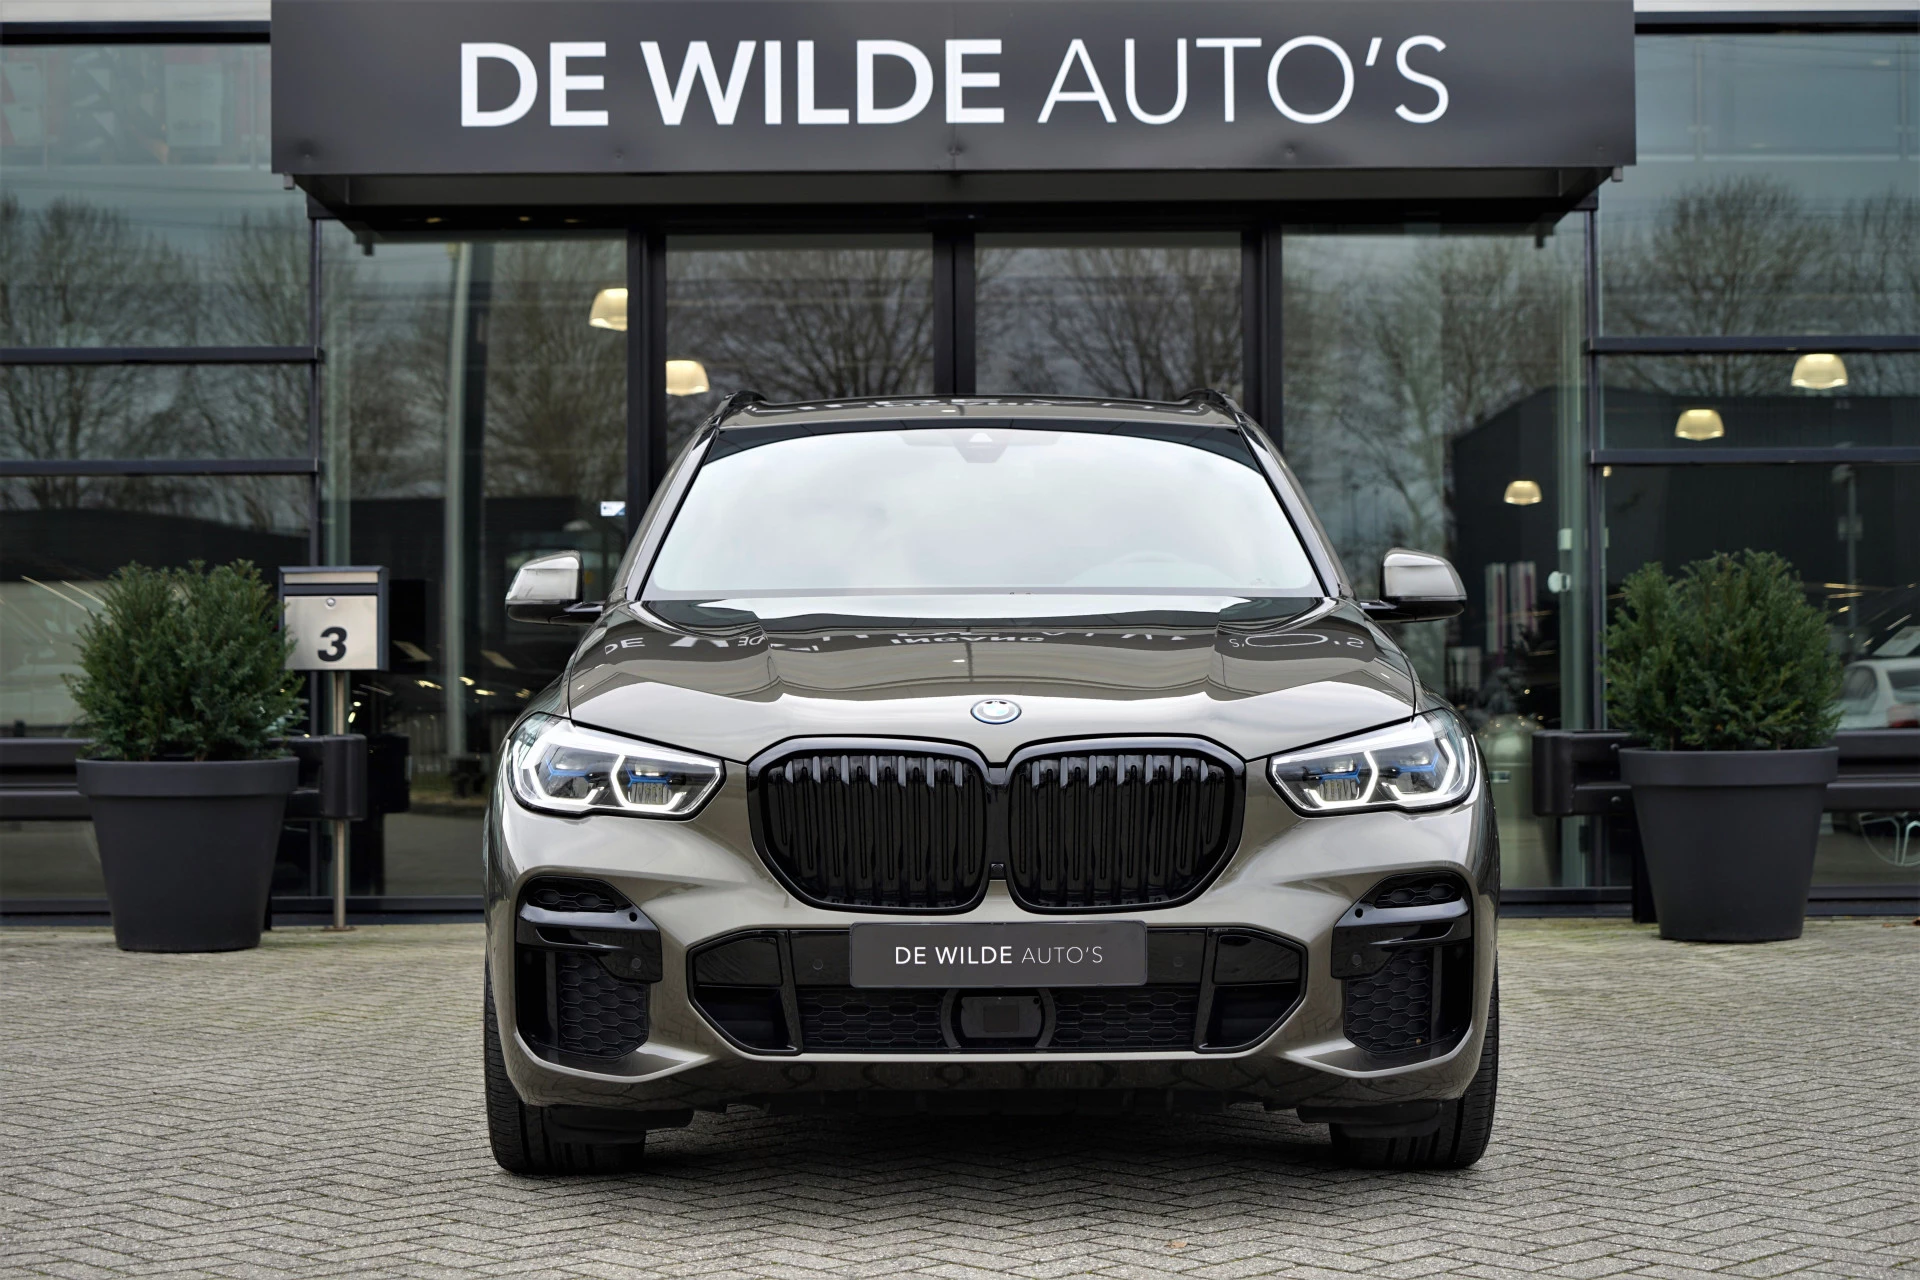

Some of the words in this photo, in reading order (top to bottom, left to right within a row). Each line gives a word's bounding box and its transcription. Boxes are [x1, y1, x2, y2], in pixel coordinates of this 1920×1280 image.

[460, 41, 609, 127] DE
[639, 38, 1005, 126] WILDE
[1037, 35, 1449, 125] AUTO'S
[317, 626, 348, 662] 3
[895, 946, 927, 965] DE
[934, 945, 1013, 965] WILDE
[1021, 945, 1103, 964] AUTO'S
